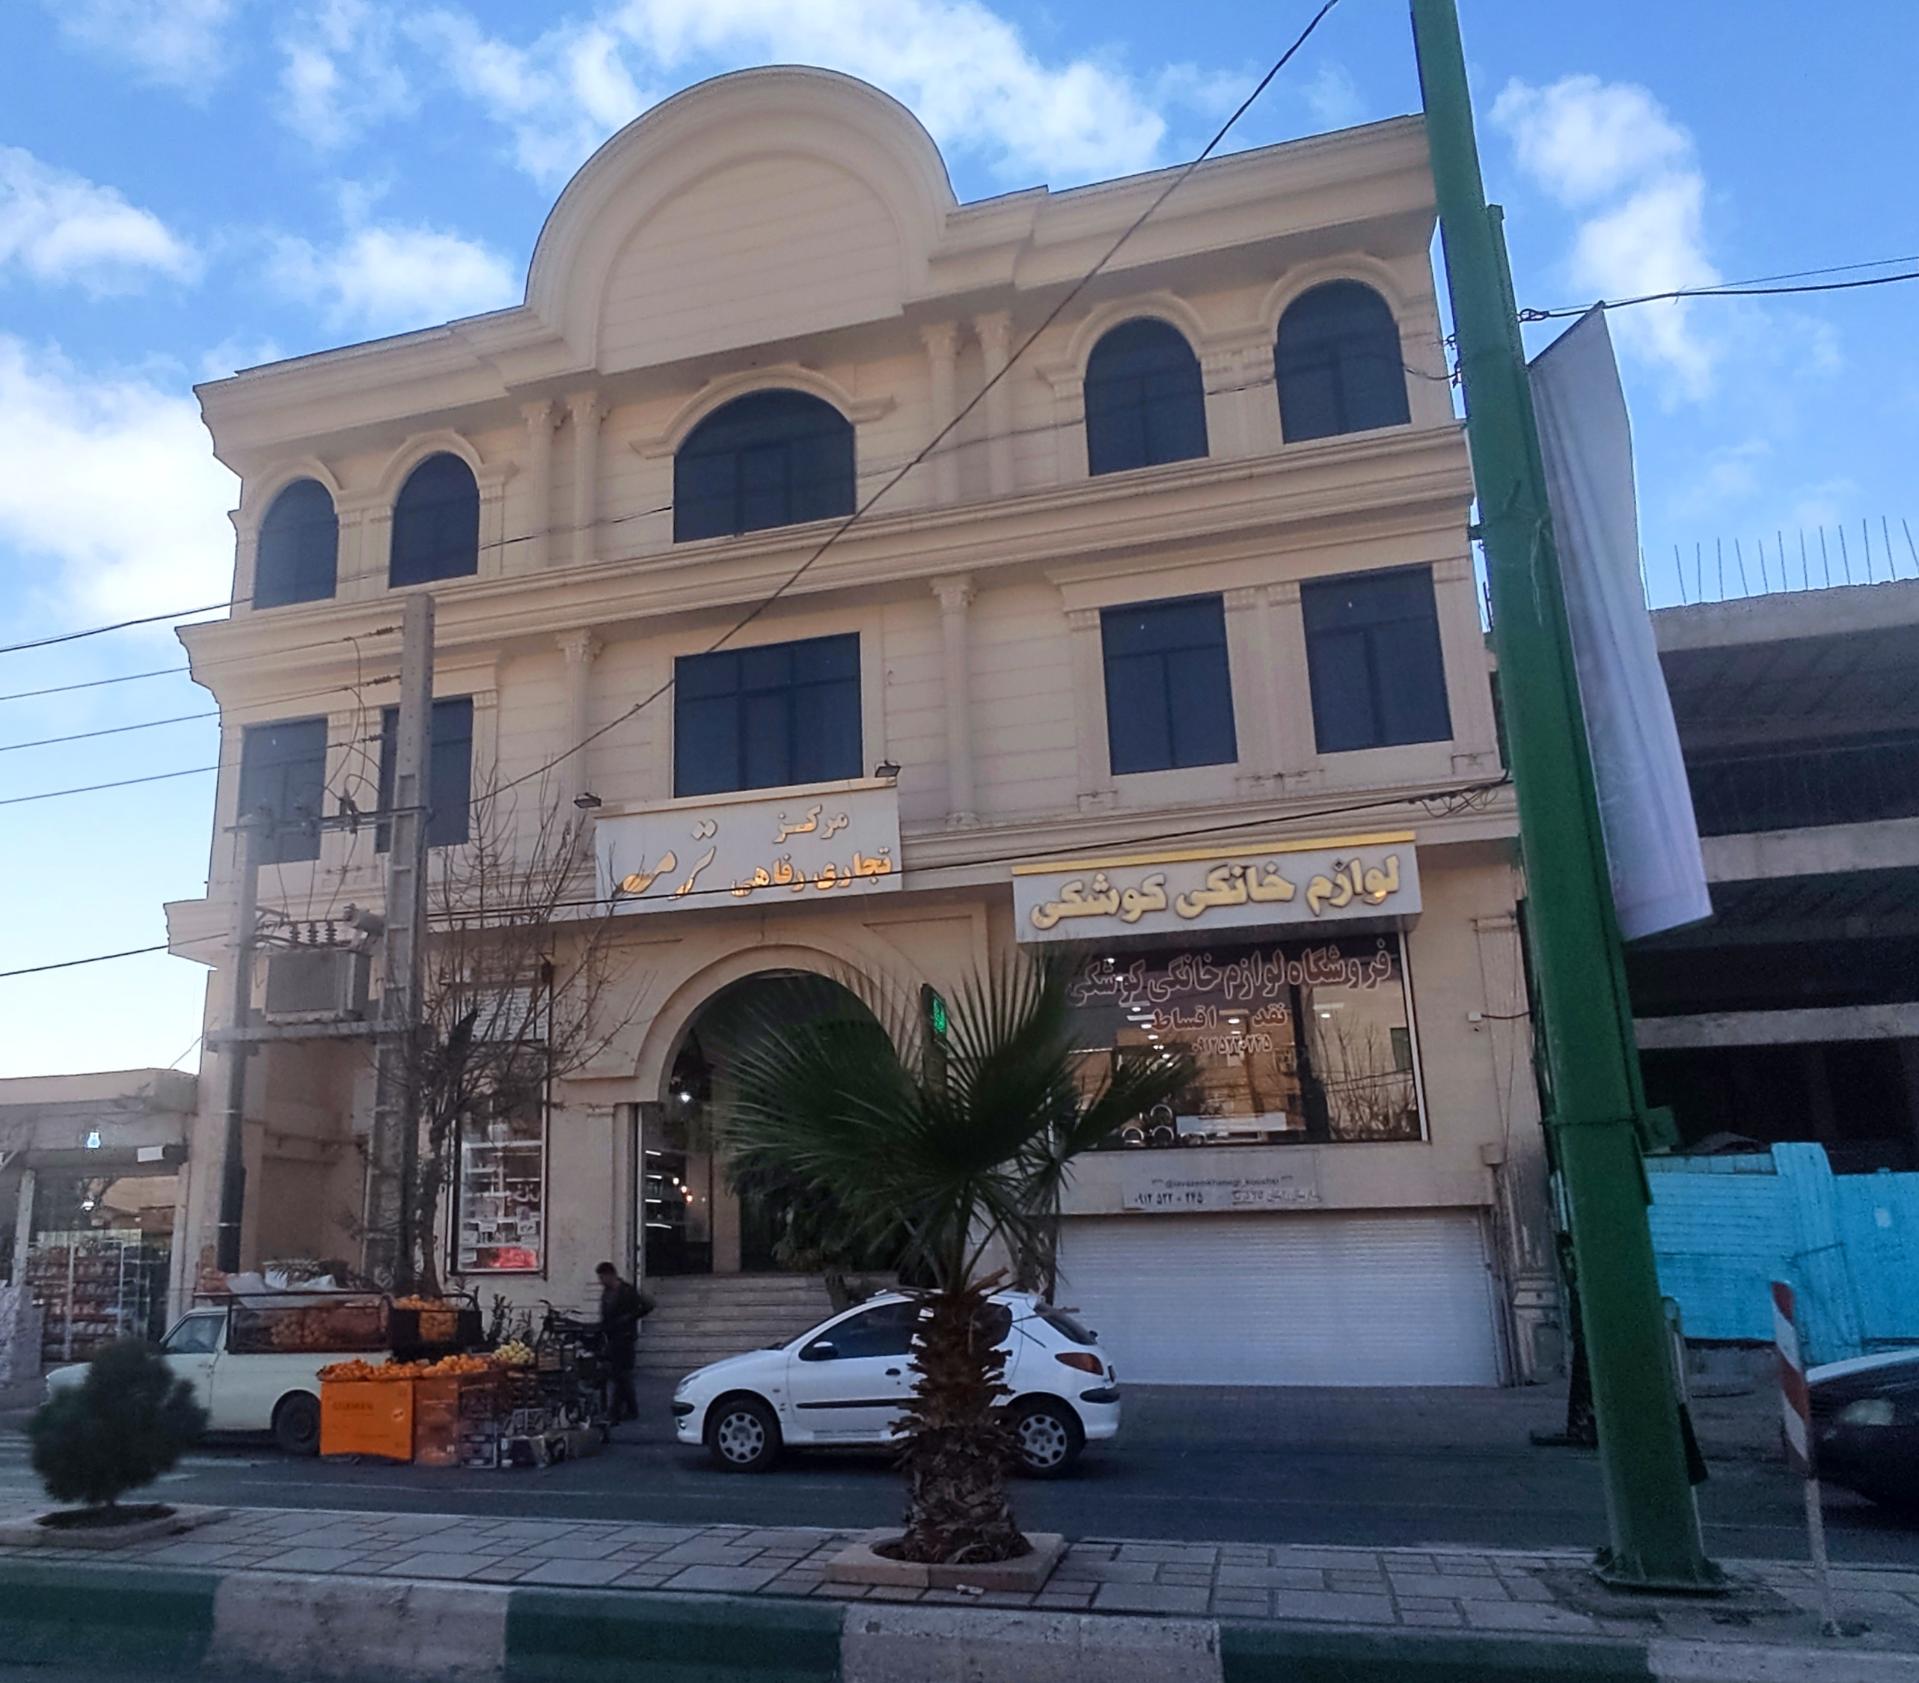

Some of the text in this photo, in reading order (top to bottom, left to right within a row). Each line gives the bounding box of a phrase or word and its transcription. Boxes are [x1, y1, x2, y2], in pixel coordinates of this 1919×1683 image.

[773, 804, 849, 843] مرکز
[730, 847, 893, 897] تجاری رفاهی
[1306, 854, 1400, 917] لوازم
[1030, 872, 1170, 931] کوشکی
[1147, 952, 1222, 1003] خانگی
[1223, 947, 1286, 1001] لوازم
[1287, 937, 1392, 992] فروشگاه
[1149, 1002, 1290, 1033] نقد اقساط
